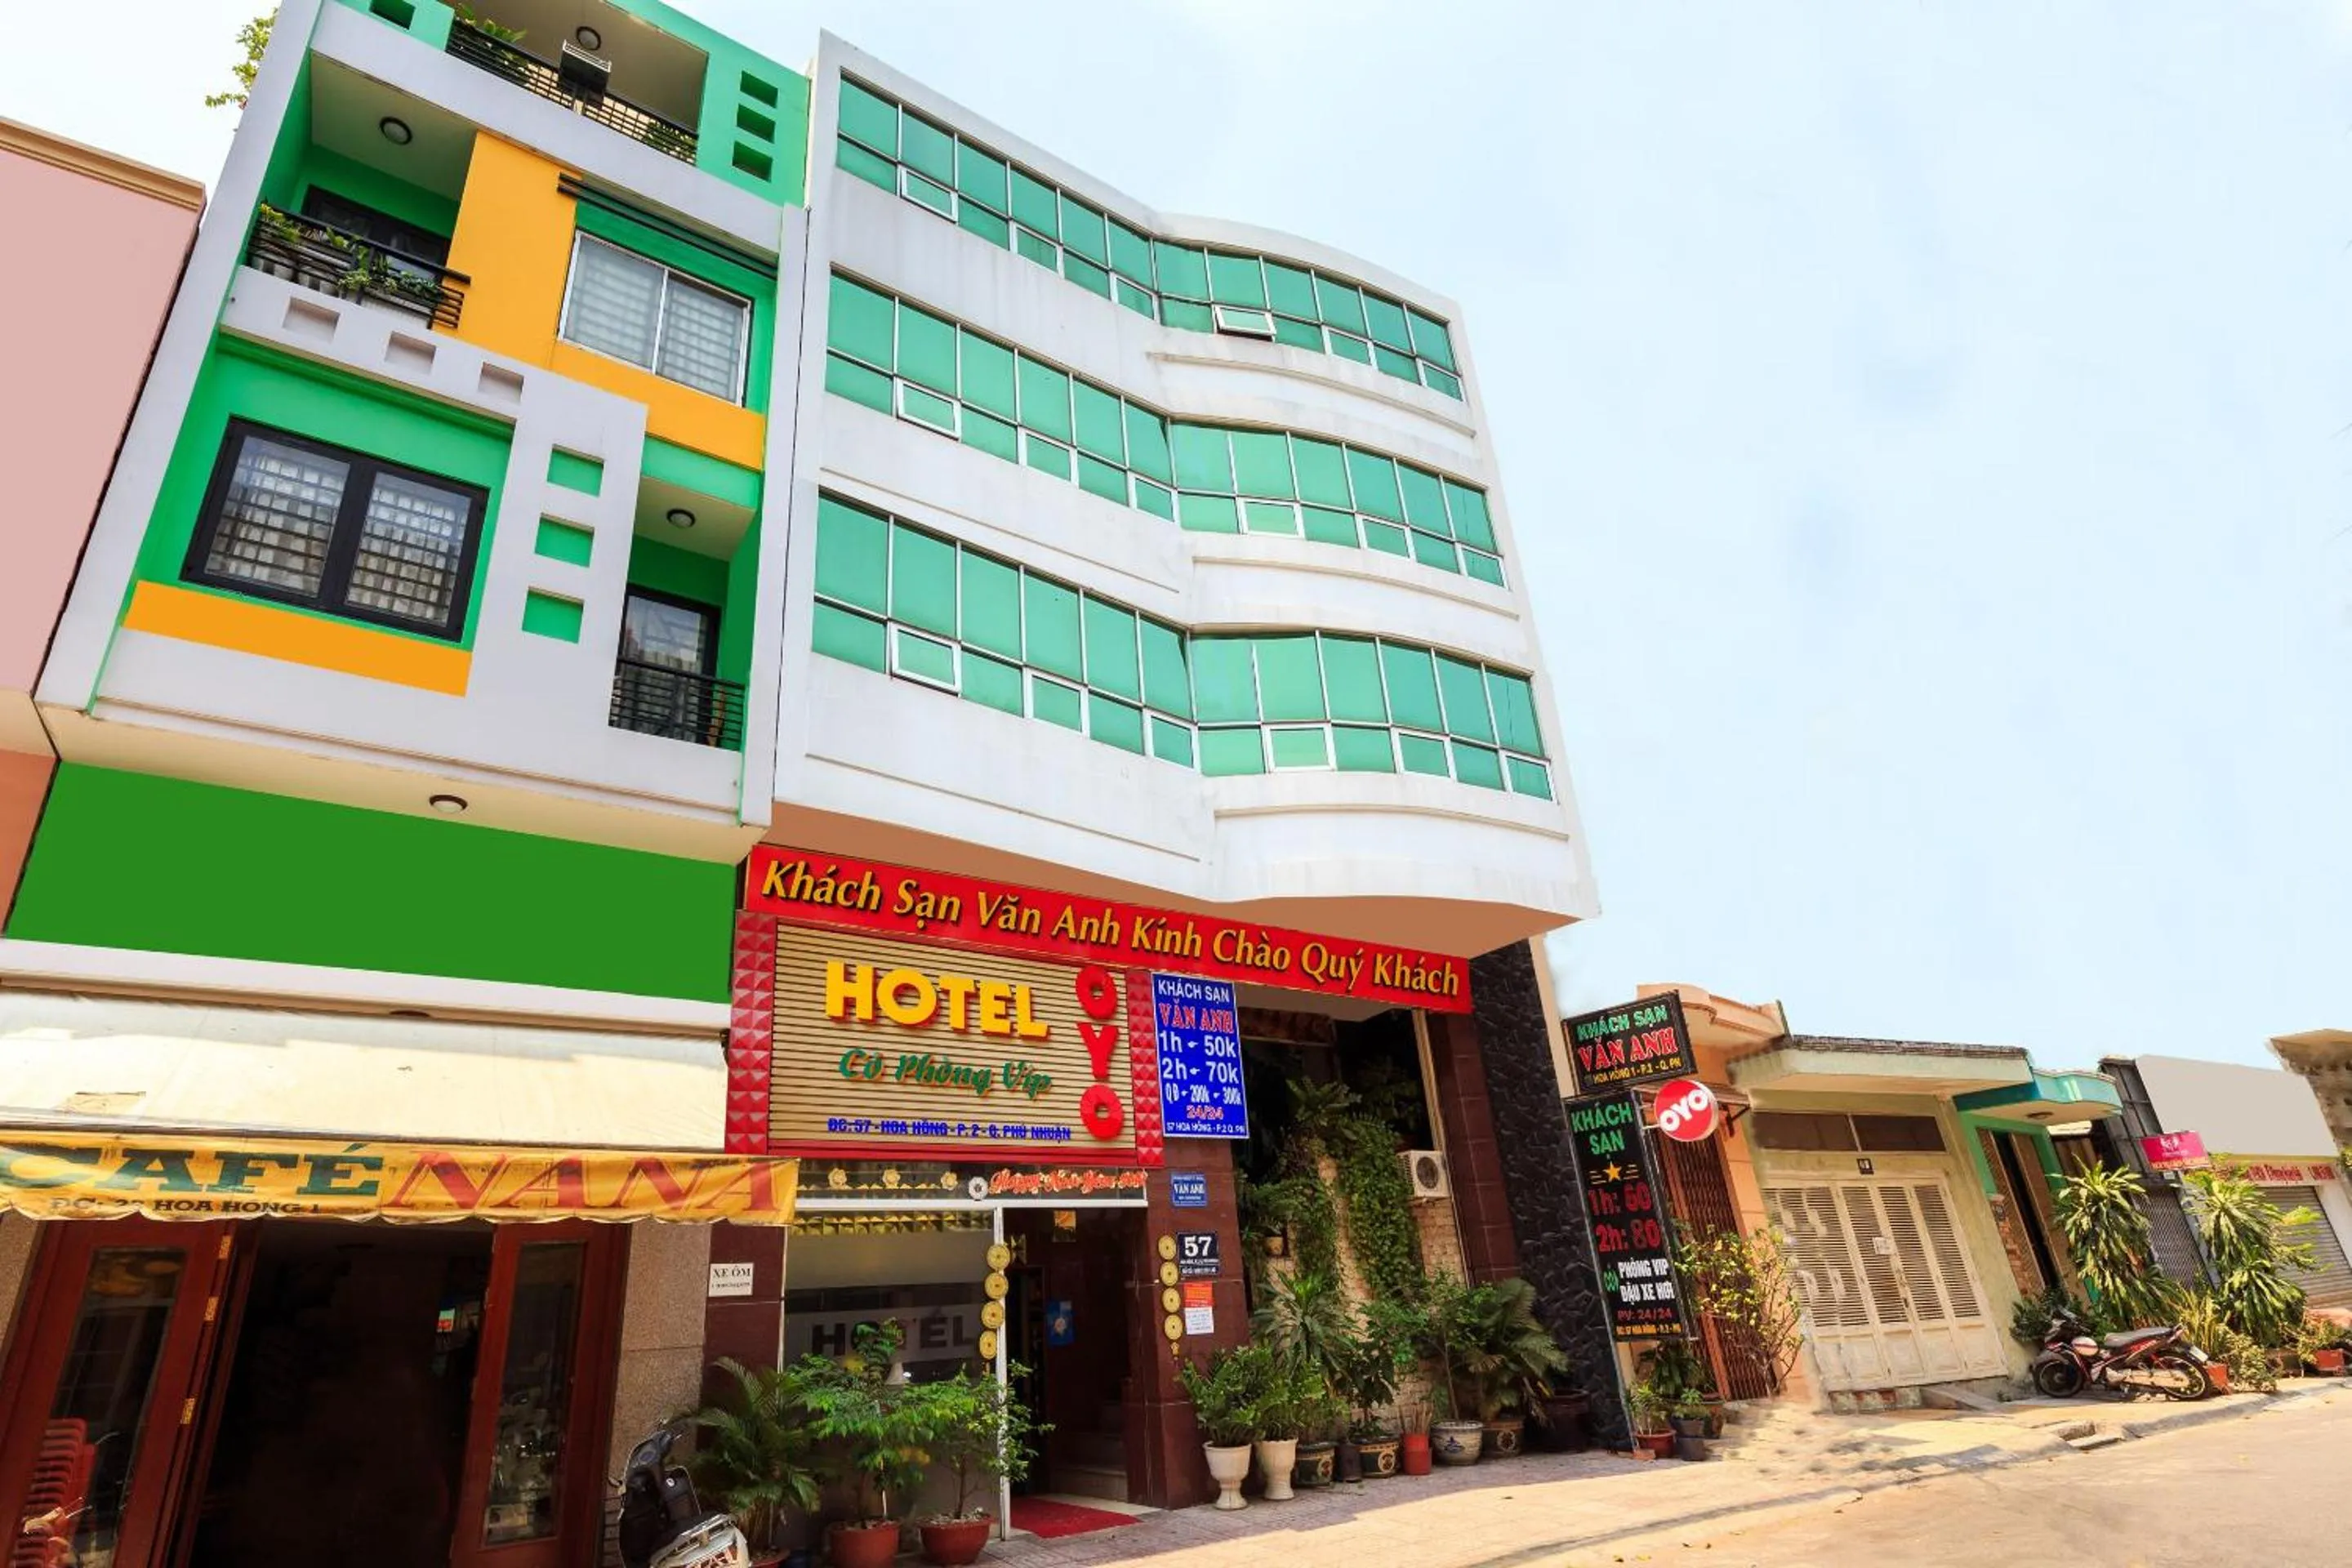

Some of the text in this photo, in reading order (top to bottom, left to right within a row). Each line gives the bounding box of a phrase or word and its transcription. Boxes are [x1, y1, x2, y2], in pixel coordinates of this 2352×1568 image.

[762, 860, 1460, 998] Khách Sạn Văn Anh Kính Chào Quý Khách
[825, 959, 1050, 1040] HOTEL
[1157, 978, 1231, 1004] KHÁCH SẠN
[1158, 999, 1235, 1035] VĂN ANH
[1576, 1004, 1668, 1043] KHÁCH SẠN
[1159, 1029, 1237, 1058] 1h 50k
[1577, 1027, 1679, 1072] VĂN ANH
[895, 1053, 994, 1097] Phòng
[1003, 1060, 1053, 1100] Vip
[1160, 1057, 1240, 1085] 2h 70k
[880, 1119, 908, 1135] HOA
[1659, 1089, 1709, 1132] OYO
[1570, 1102, 1634, 1160] KHÁCH SẠN
[0, 1143, 782, 1212] CAFÉ NANA
[154, 1199, 214, 1212] HOA
[1183, 1235, 1213, 1258] 57
[1618, 1256, 1670, 1279] PHÒNG VIP
[1640, 1283, 1656, 1301] XE
